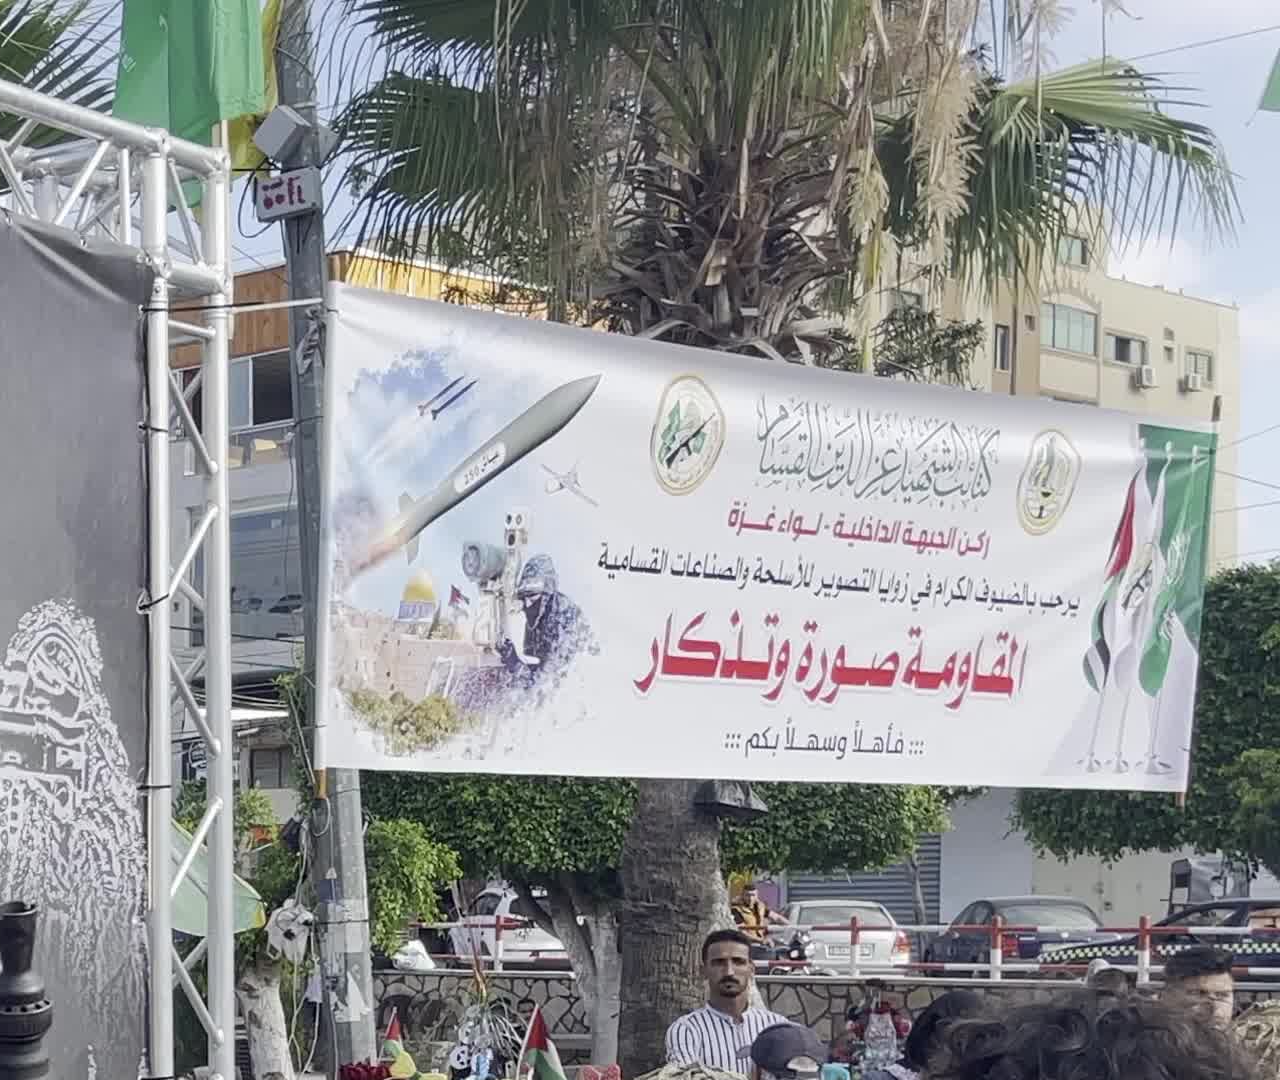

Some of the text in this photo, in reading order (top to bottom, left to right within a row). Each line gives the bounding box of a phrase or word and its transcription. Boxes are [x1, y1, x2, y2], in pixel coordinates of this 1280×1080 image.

[727, 501, 777, 536] غزة
[778, 509, 823, 542] لواء
[832, 512, 902, 548] الداخلية
[902, 520, 957, 556] الجبهة
[957, 529, 991, 560] ركن
[597, 541, 1081, 617] يرحب بالضيوف الكرام في زوايا التصوير للأسلحة والصناعات القسامية
[632, 608, 1030, 711] المقاومة صورة وتذكار
[744, 725, 781, 759] بكم
